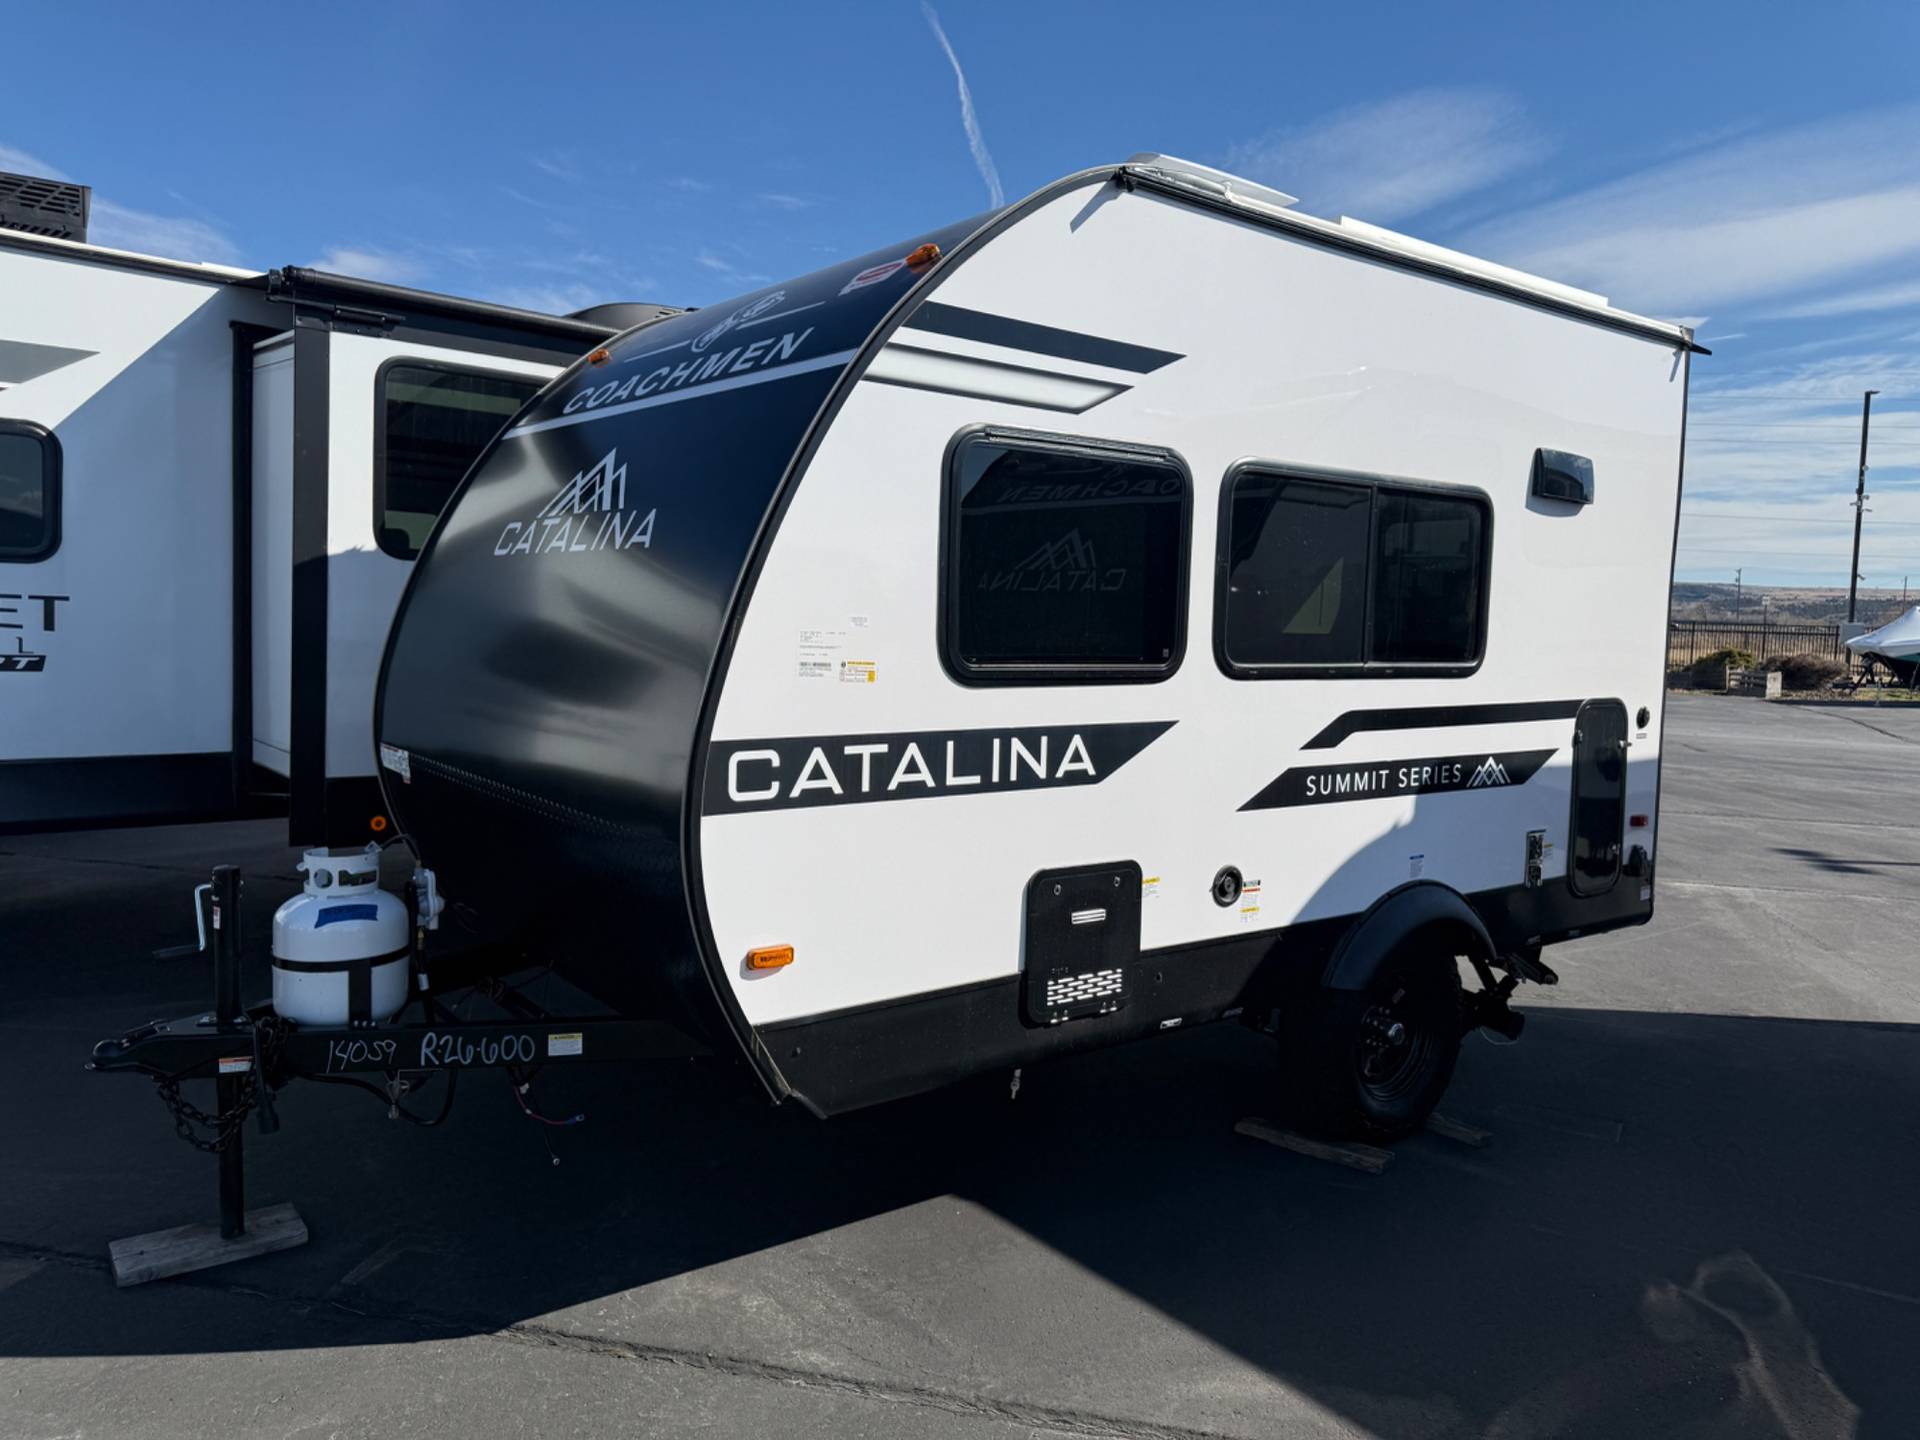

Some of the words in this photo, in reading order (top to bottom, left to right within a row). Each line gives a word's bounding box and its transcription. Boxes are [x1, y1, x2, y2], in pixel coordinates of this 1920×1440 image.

[563, 327, 814, 414] COACHMEN
[494, 508, 656, 555] CATALINA
[728, 734, 1097, 802] CATALINA
[1306, 770, 1389, 796] SUMMIT
[1398, 764, 1462, 788] SERIES
[326, 1039, 397, 1074] 14059
